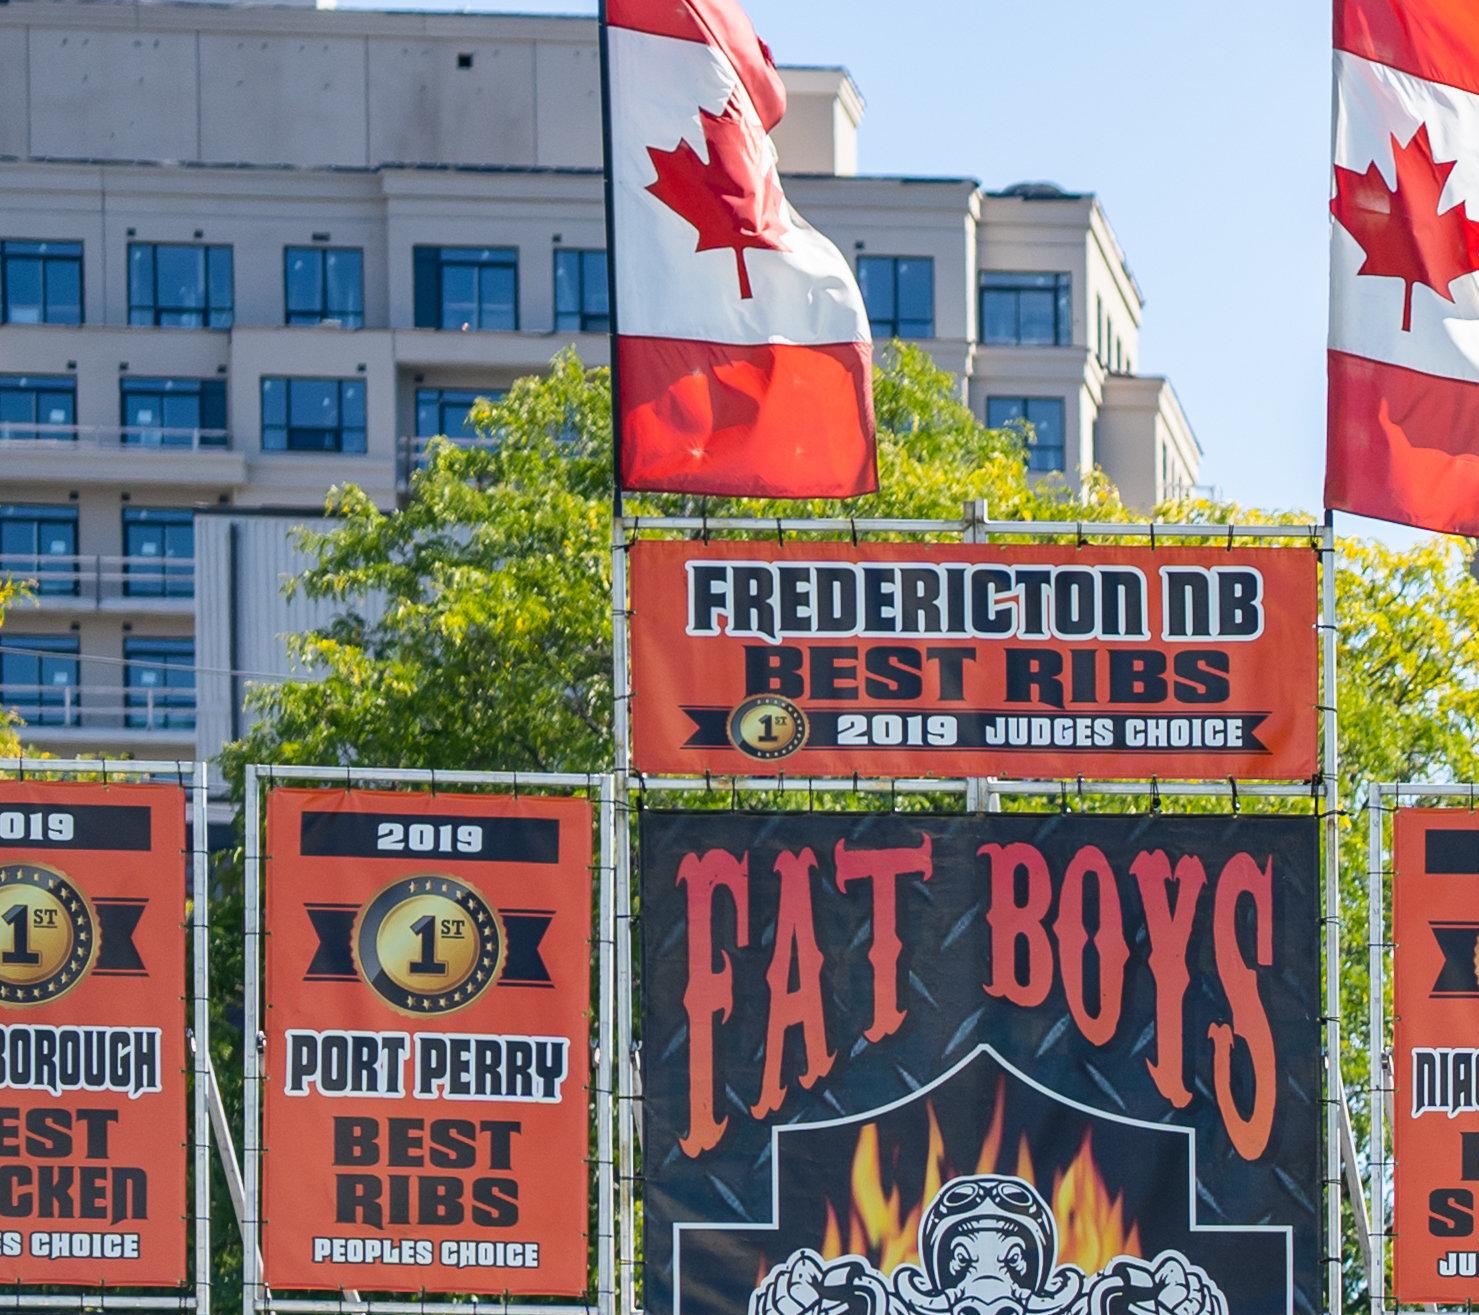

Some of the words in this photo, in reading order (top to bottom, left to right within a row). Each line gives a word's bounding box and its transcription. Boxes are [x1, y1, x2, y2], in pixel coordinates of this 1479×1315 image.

[685, 561, 1150, 644] FREDERICTON
[1161, 565, 1264, 641] NB
[743, 645, 976, 701] BEST
[1004, 649, 1231, 709] RIBS
[837, 714, 958, 746] 2019
[985, 716, 1115, 746] JUDGES
[1124, 718, 1243, 747] CHOICE
[377, 822, 483, 852] 2019
[409, 915, 466, 974] 1ST
[676, 832, 932, 1158] FAT
[976, 841, 1277, 1161] BOYS
[285, 1028, 410, 1099] PORT
[414, 1031, 570, 1102] PERRY
[331, 1115, 521, 1169] BEST
[334, 1175, 520, 1229] RIBS
[313, 1238, 434, 1266] PEOPLES
[440, 1239, 539, 1270] CHOICE
